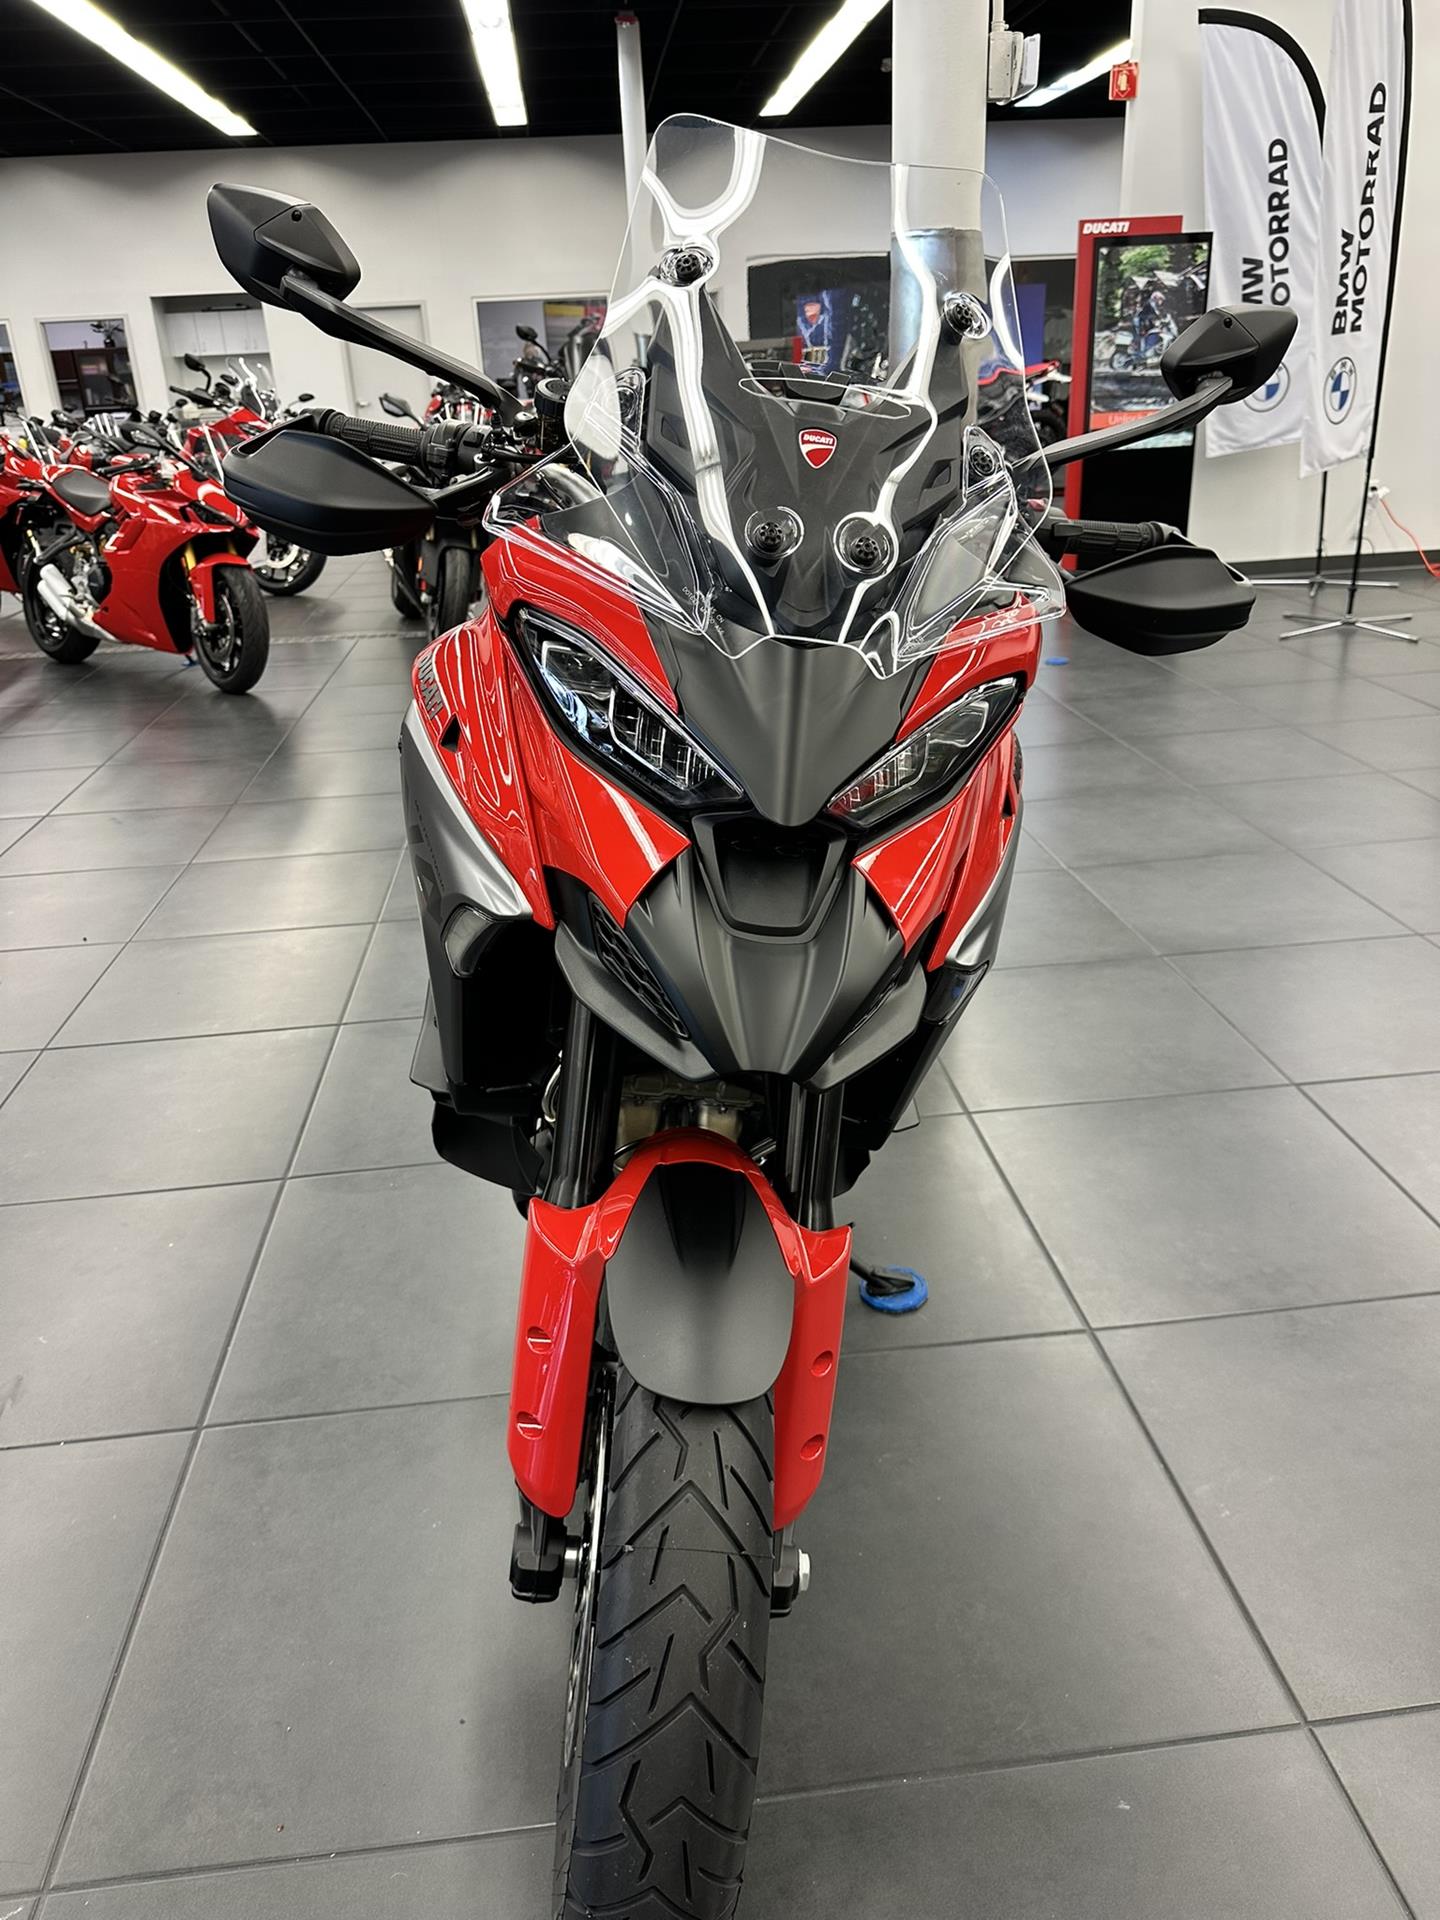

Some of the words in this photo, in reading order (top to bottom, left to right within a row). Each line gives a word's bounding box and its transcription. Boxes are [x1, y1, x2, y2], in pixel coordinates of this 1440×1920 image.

[1082, 221, 1130, 235] DUCATI
[1268, 138, 1290, 306] OTORRAD
[1350, 82, 1387, 332] MOTORRAD
[1331, 228, 1355, 336] BMW
[802, 433, 834, 445] DUCATI
[417, 650, 444, 721] DUCATI
